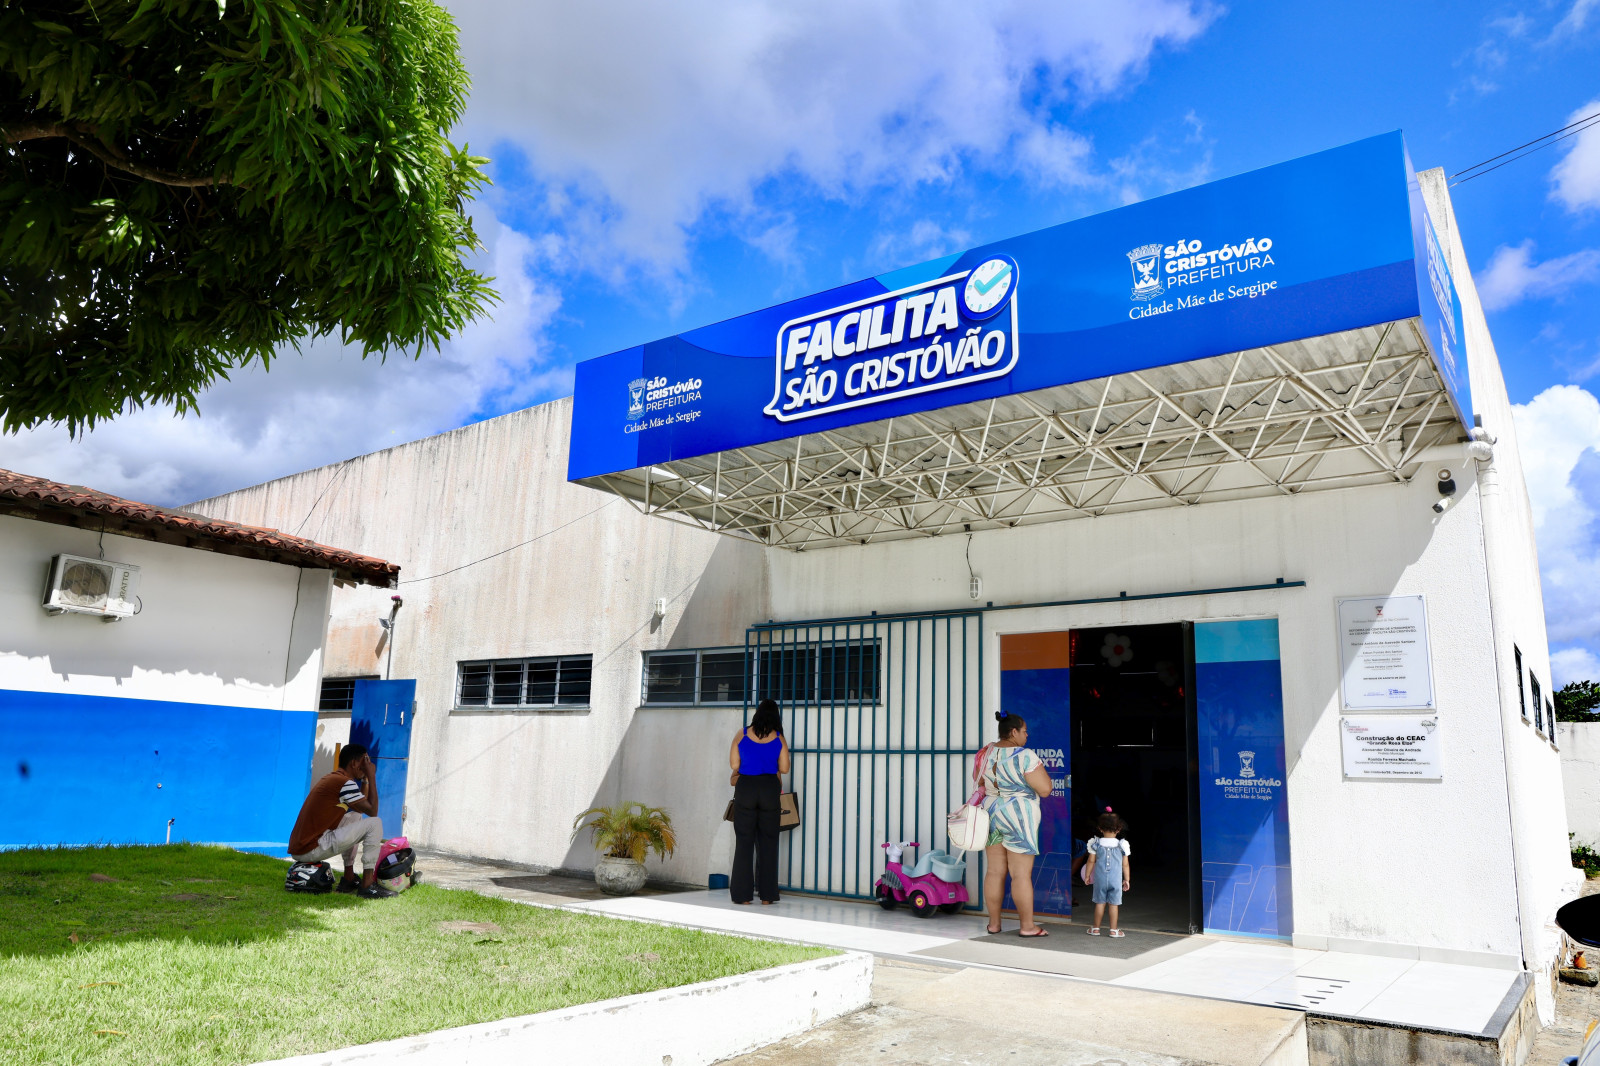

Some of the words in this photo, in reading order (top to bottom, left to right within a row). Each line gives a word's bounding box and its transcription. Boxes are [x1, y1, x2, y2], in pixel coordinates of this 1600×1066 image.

[1163, 238, 1203, 260] SÃO
[1164, 237, 1273, 274] CRISTÓVÃO
[1167, 253, 1275, 289] PREFEITURA
[1128, 300, 1174, 320] Cidade
[1176, 294, 1206, 310] Mãe
[1208, 288, 1225, 303] de
[1228, 280, 1278, 299] Sergipe
[784, 286, 959, 371] FACILITA
[783, 366, 838, 411] SÃO
[844, 326, 1006, 396] CRISTÓVÃO
[646, 376, 667, 391] SÃO
[646, 378, 702, 402] CRISTÓVÃO
[645, 390, 702, 413] PREFEITURA
[624, 420, 648, 434] Cidade
[649, 417, 665, 429] Mãe
[665, 414, 675, 425] de
[675, 409, 702, 423] Sergipe
[1215, 777, 1232, 786] SÃO
[1233, 777, 1281, 787] CRISTÓVÃO
[1224, 786, 1272, 794] PREFEITURA
